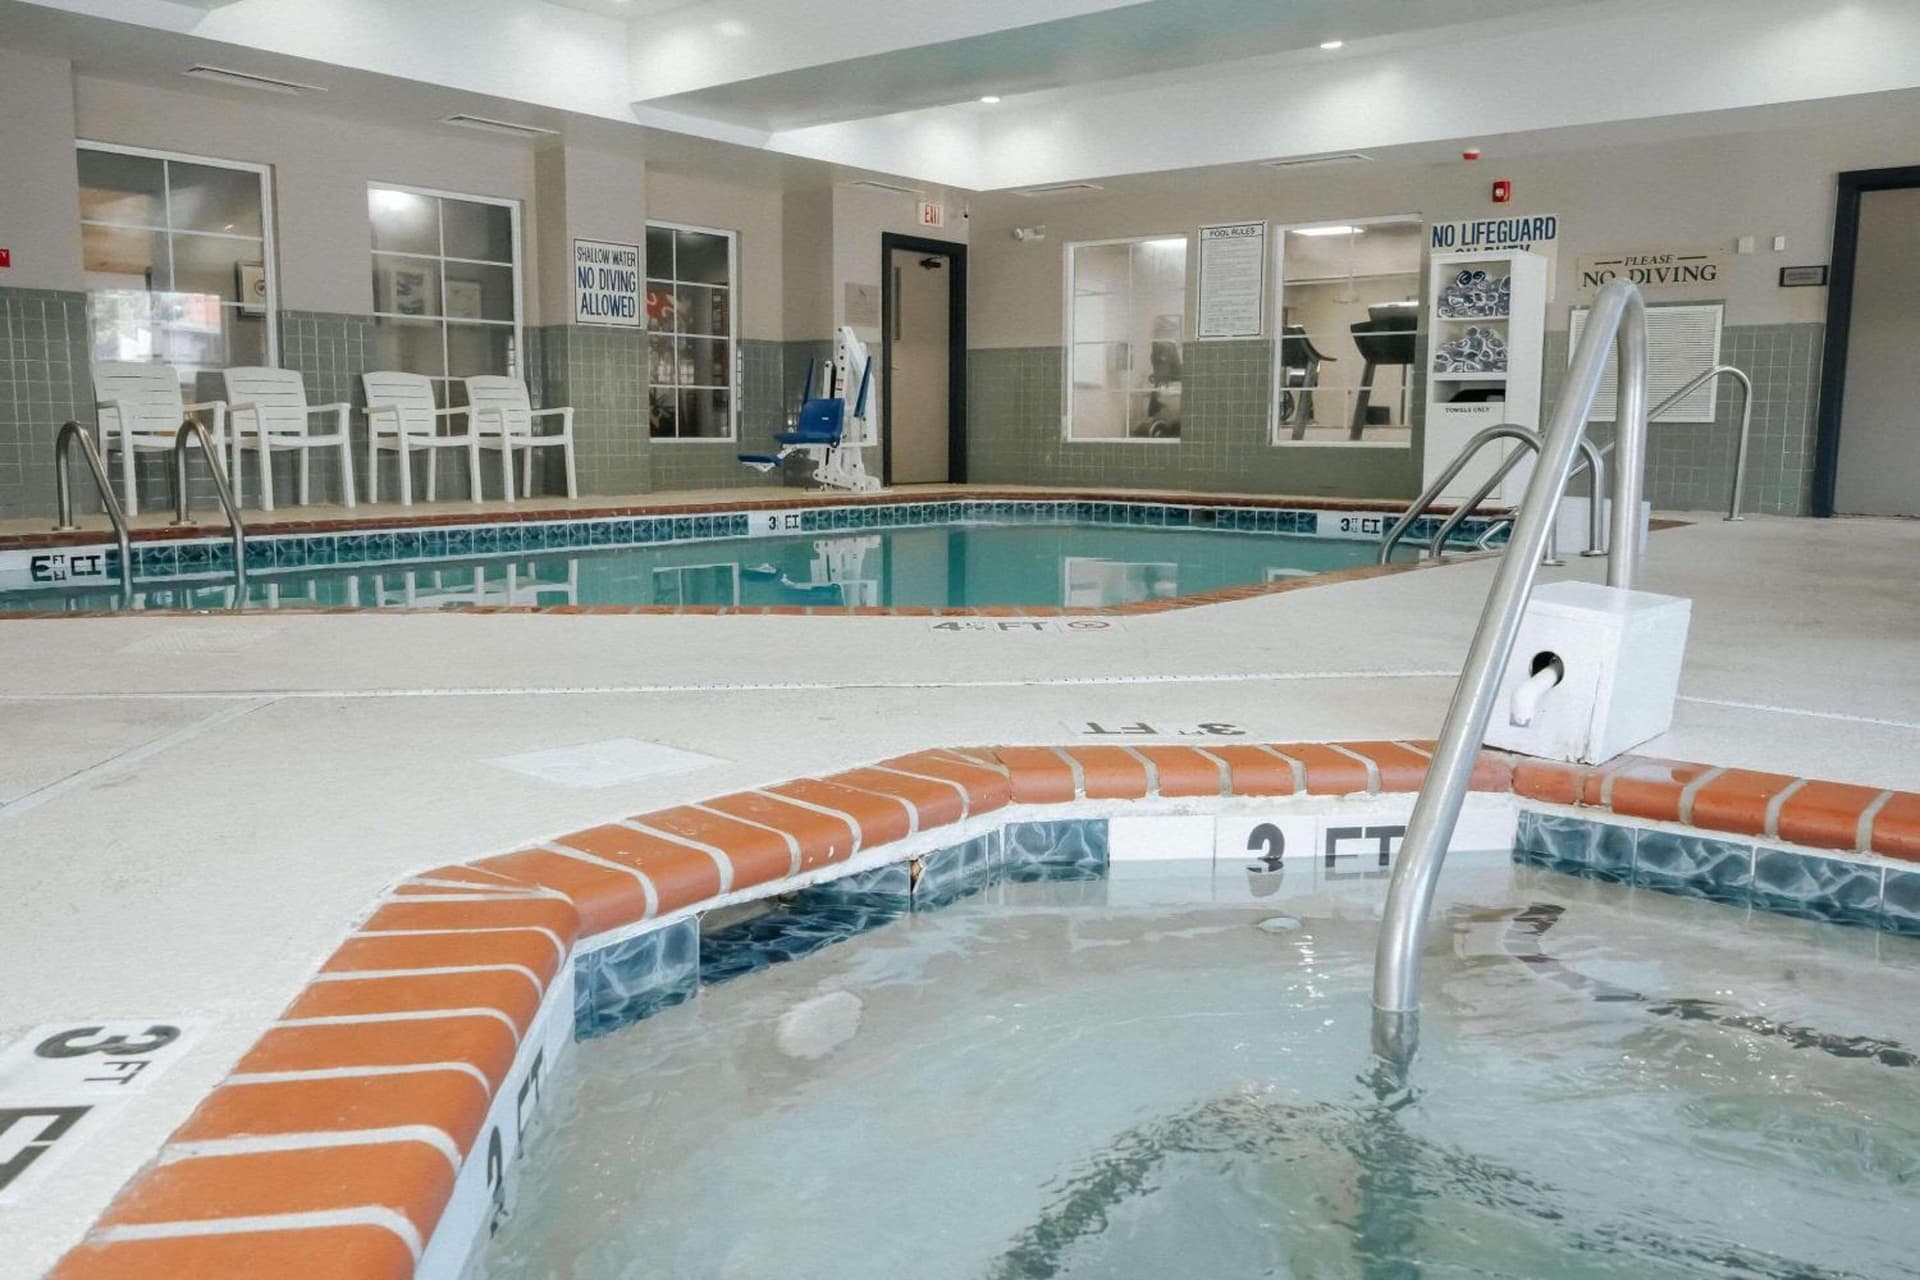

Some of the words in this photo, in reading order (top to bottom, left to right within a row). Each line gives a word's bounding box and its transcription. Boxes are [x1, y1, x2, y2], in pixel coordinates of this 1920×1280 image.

[925, 204, 940, 224] EXIT
[1231, 227, 1256, 235] RULES
[1432, 224, 1455, 248] NO
[1461, 216, 1556, 246] LIFEGUARD
[576, 246, 609, 264] SHALLOW
[612, 250, 636, 267] WATER
[1624, 254, 1674, 266] PLEASE
[577, 266, 595, 289] NO
[600, 268, 636, 293] DIVING
[1628, 264, 1717, 284] DIVING
[580, 292, 636, 318] ALLOWED
[998, 621, 1048, 631] FT
[1082, 722, 1159, 735] FT
[34, 1025, 181, 1059] 3
